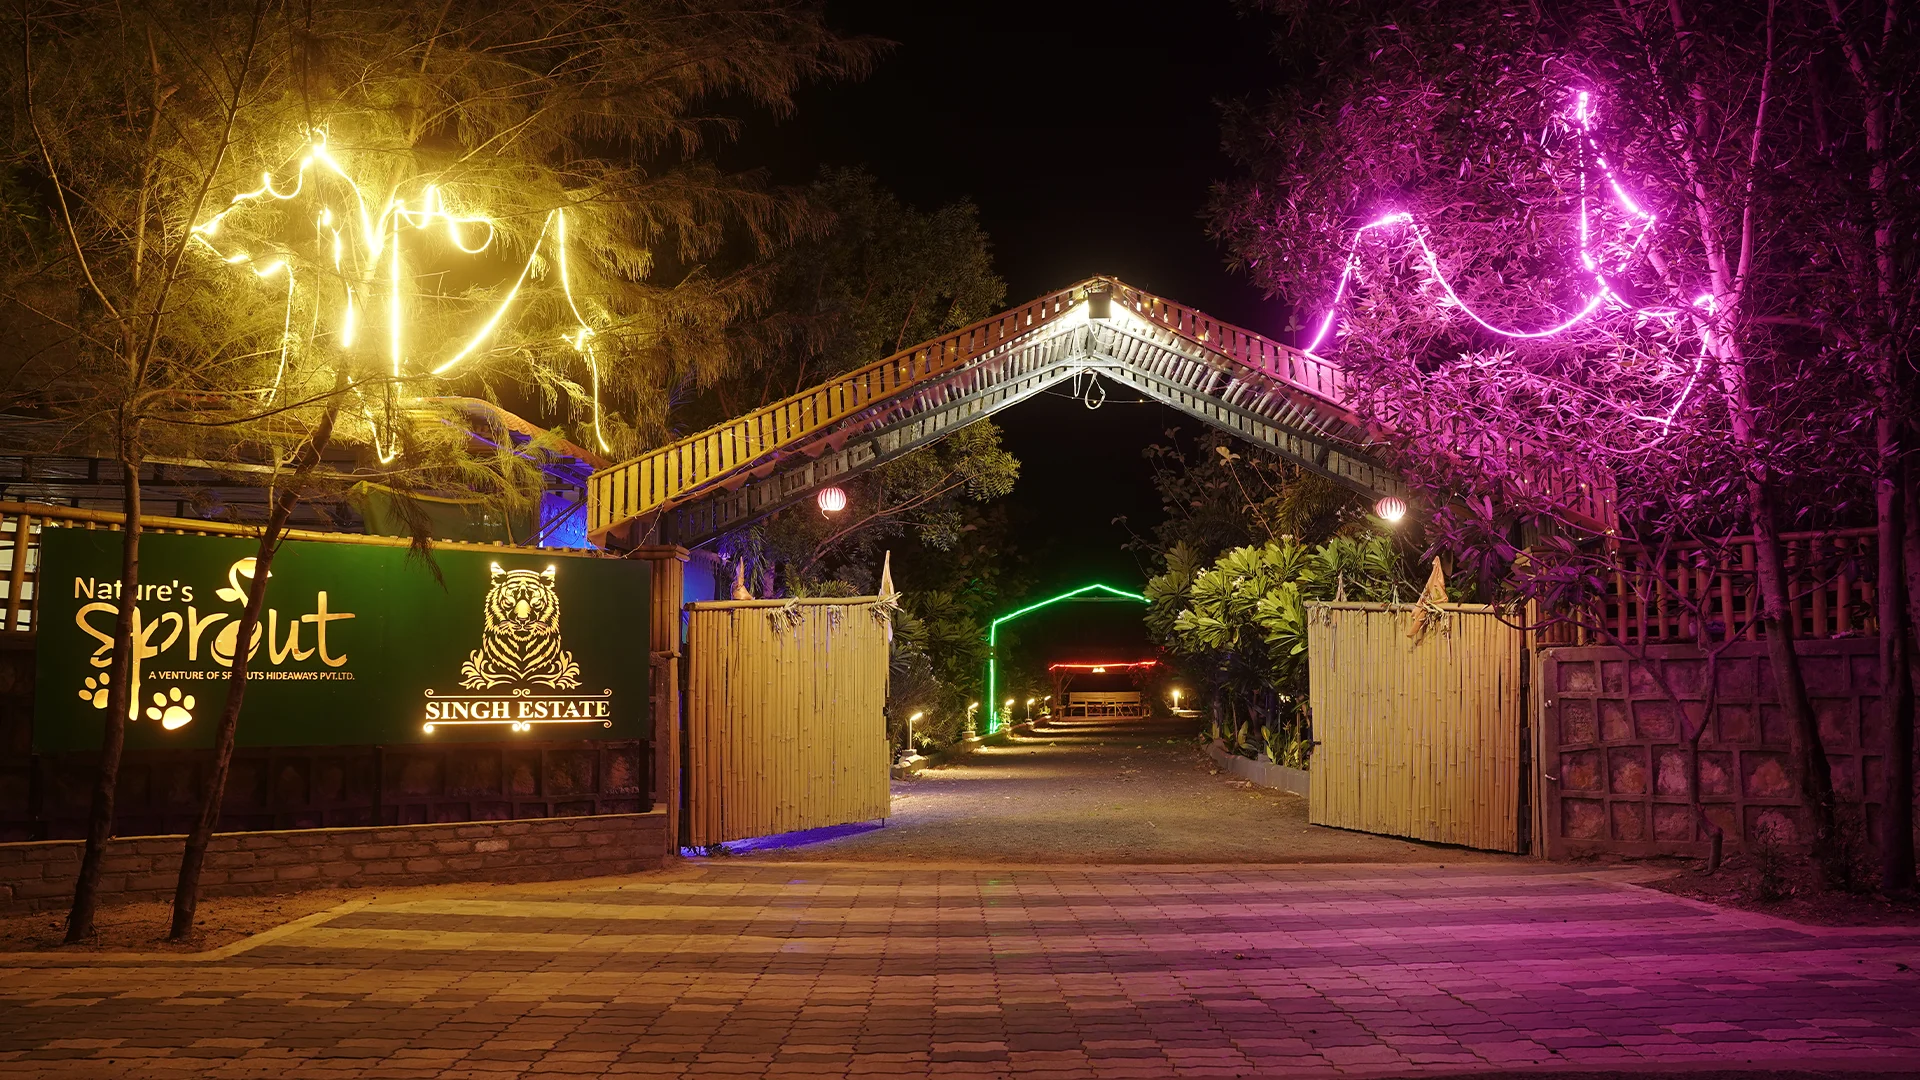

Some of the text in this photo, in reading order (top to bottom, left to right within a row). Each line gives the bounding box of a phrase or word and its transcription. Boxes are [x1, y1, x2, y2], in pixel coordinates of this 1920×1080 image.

[148, 671, 157, 680] A
[158, 670, 204, 680] VENTURE
[206, 671, 220, 680] OF
[221, 671, 265, 680] SPUTS
[266, 671, 318, 680] HIDEAWAYS
[425, 700, 610, 720] SINGH ESTATE
